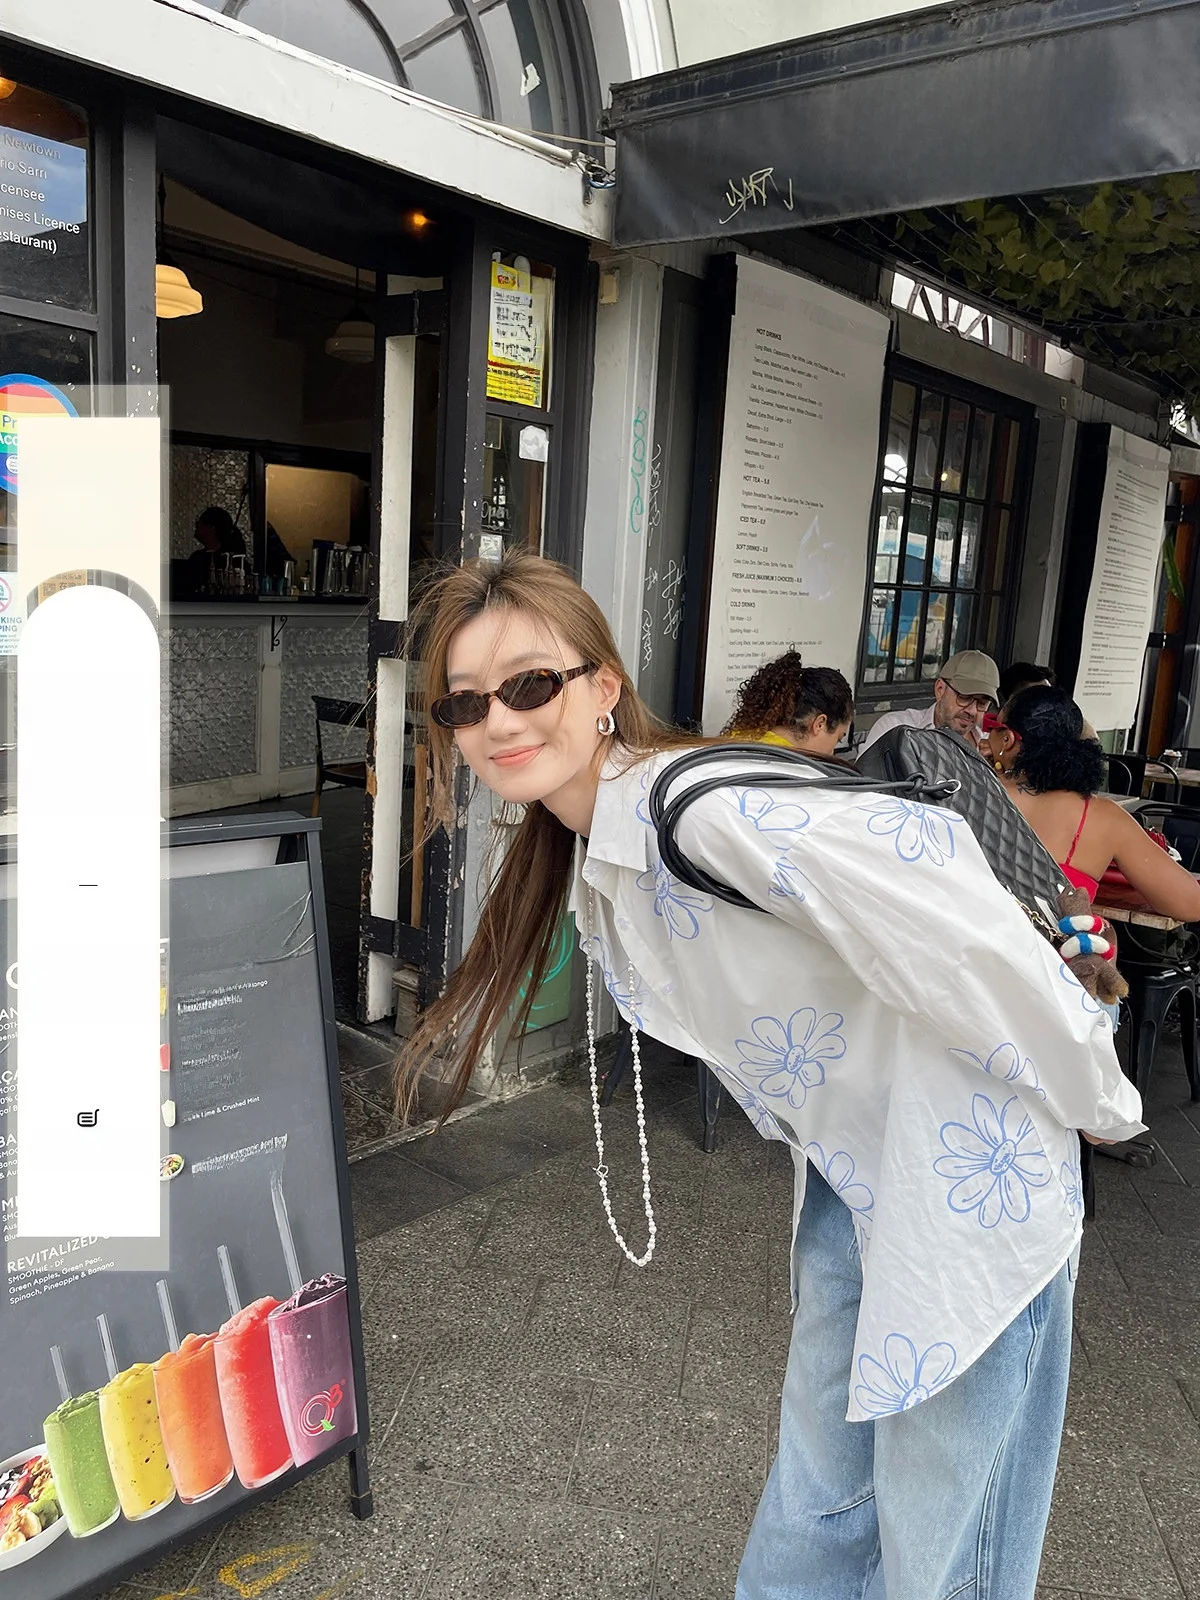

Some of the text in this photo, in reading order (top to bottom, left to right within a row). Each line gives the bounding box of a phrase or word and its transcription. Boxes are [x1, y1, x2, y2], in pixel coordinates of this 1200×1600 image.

[4, 133, 61, 160] Newtown
[34, 212, 80, 234] Licence
[766, 330, 781, 340] DRINKS
[222, 1100, 247, 1112] Crushed
[247, 1096, 260, 1105] Mint
[7, 1236, 98, 1274] REVITALIZED
[8, 1265, 48, 1284] SMOOTHIE
[55, 1258, 65, 1268] DF
[9, 1257, 103, 1294] Green Apples, Green Pear,
[10, 1288, 42, 1305] Spinach,
[43, 1274, 79, 1293] Pineapple
[88, 1261, 115, 1275] Banana
